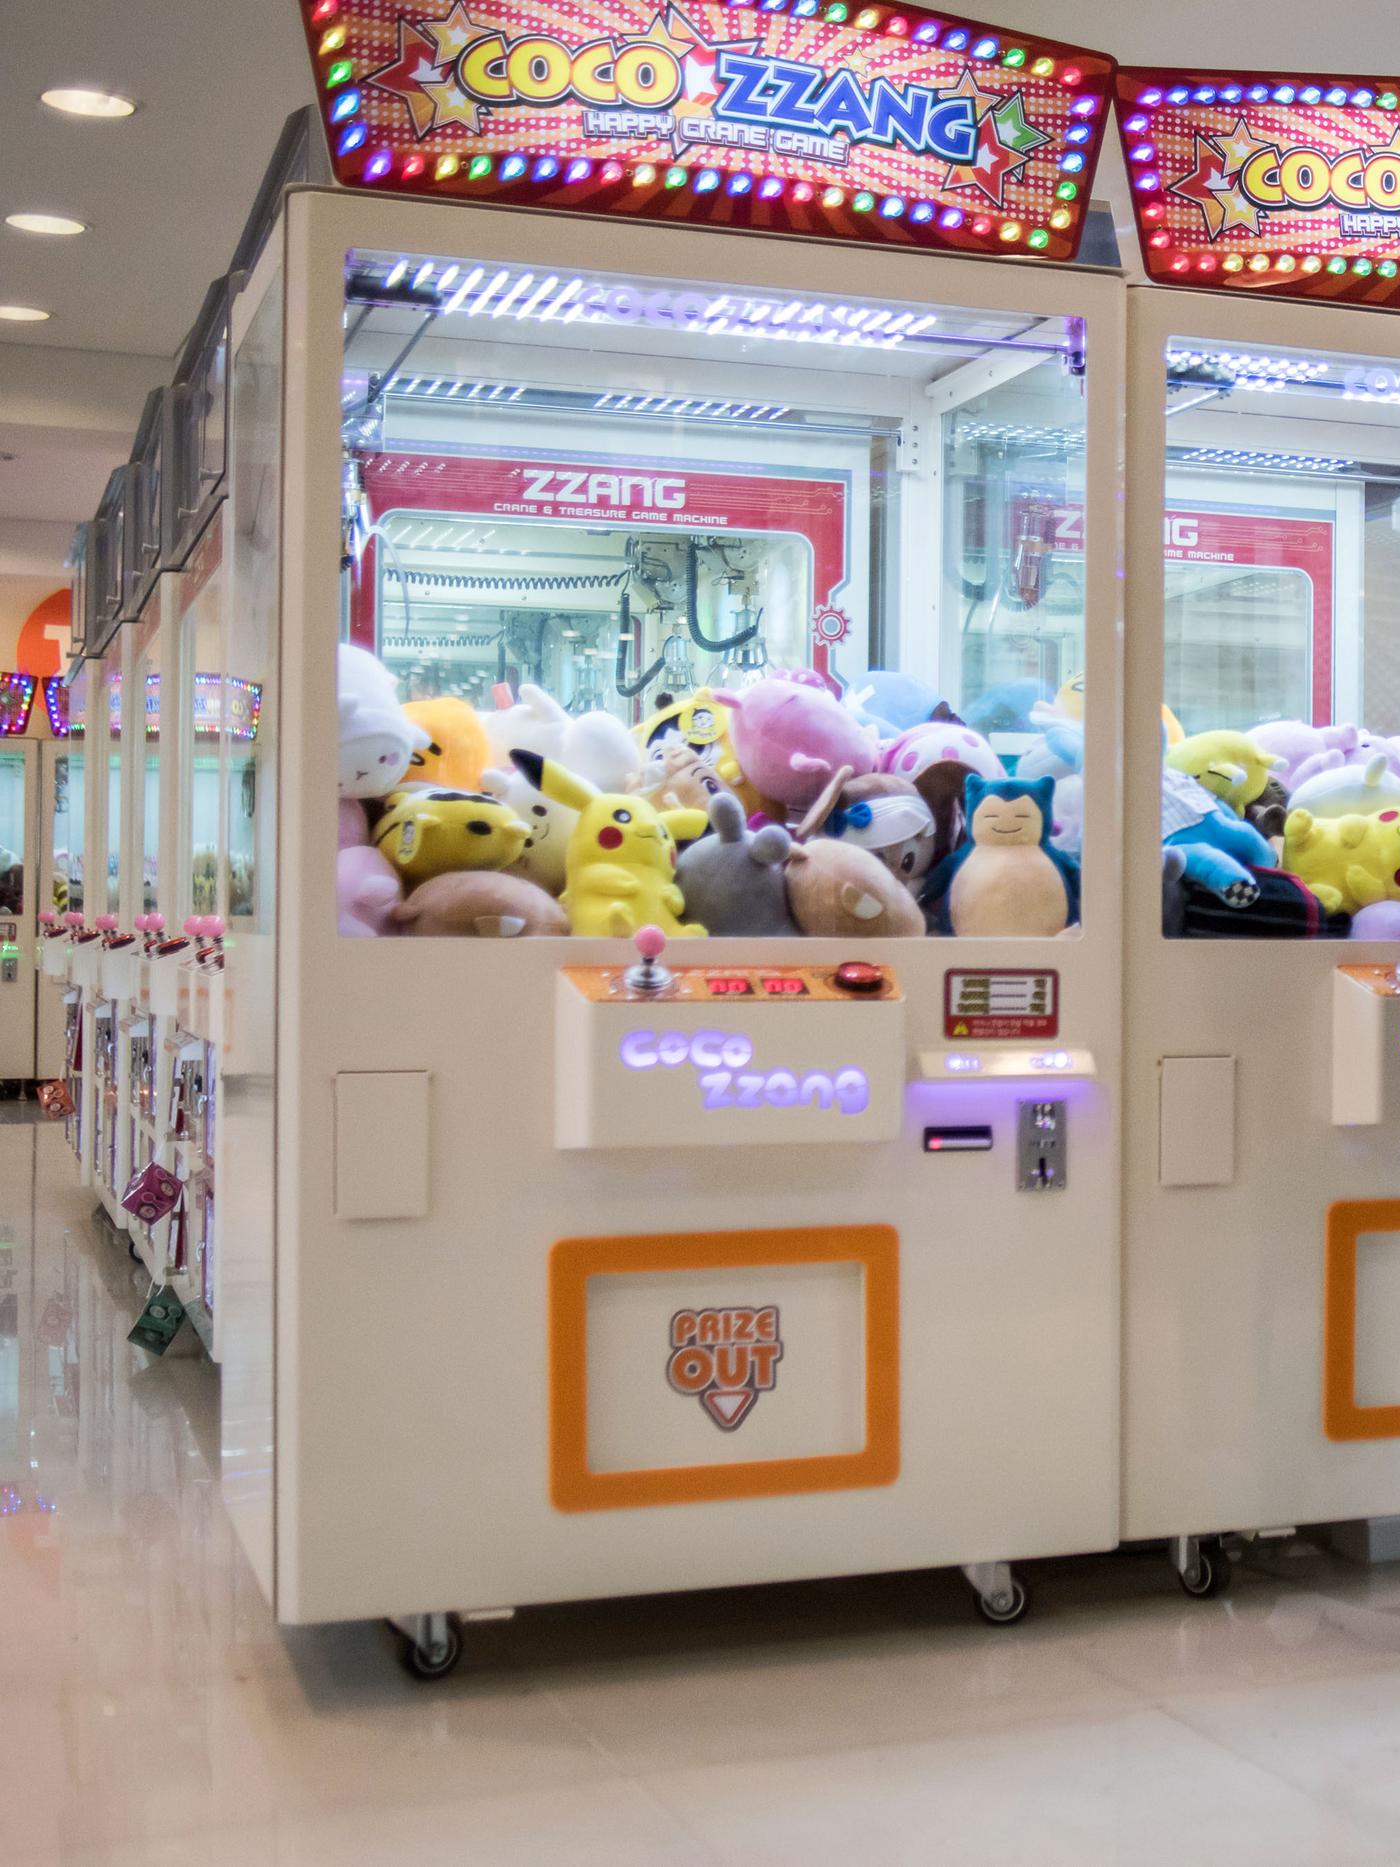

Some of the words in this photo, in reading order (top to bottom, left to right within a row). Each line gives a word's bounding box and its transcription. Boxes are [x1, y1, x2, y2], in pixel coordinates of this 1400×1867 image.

[457, 33, 684, 110] COCO
[715, 53, 978, 164] ZZANG
[585, 111, 675, 138] HAPPY
[773, 129, 850, 166] GAME
[523, 468, 686, 509] ZZANG
[493, 502, 538, 514] CRANE
[543, 504, 553, 515] &
[558, 506, 627, 520] TREASURE
[631, 510, 668, 522] GAME
[672, 513, 729, 526] MACHINE
[1187, 551, 1235, 562] MACHINE
[671, 1307, 779, 1347] PRIZE
[667, 1343, 783, 1394] OUT
